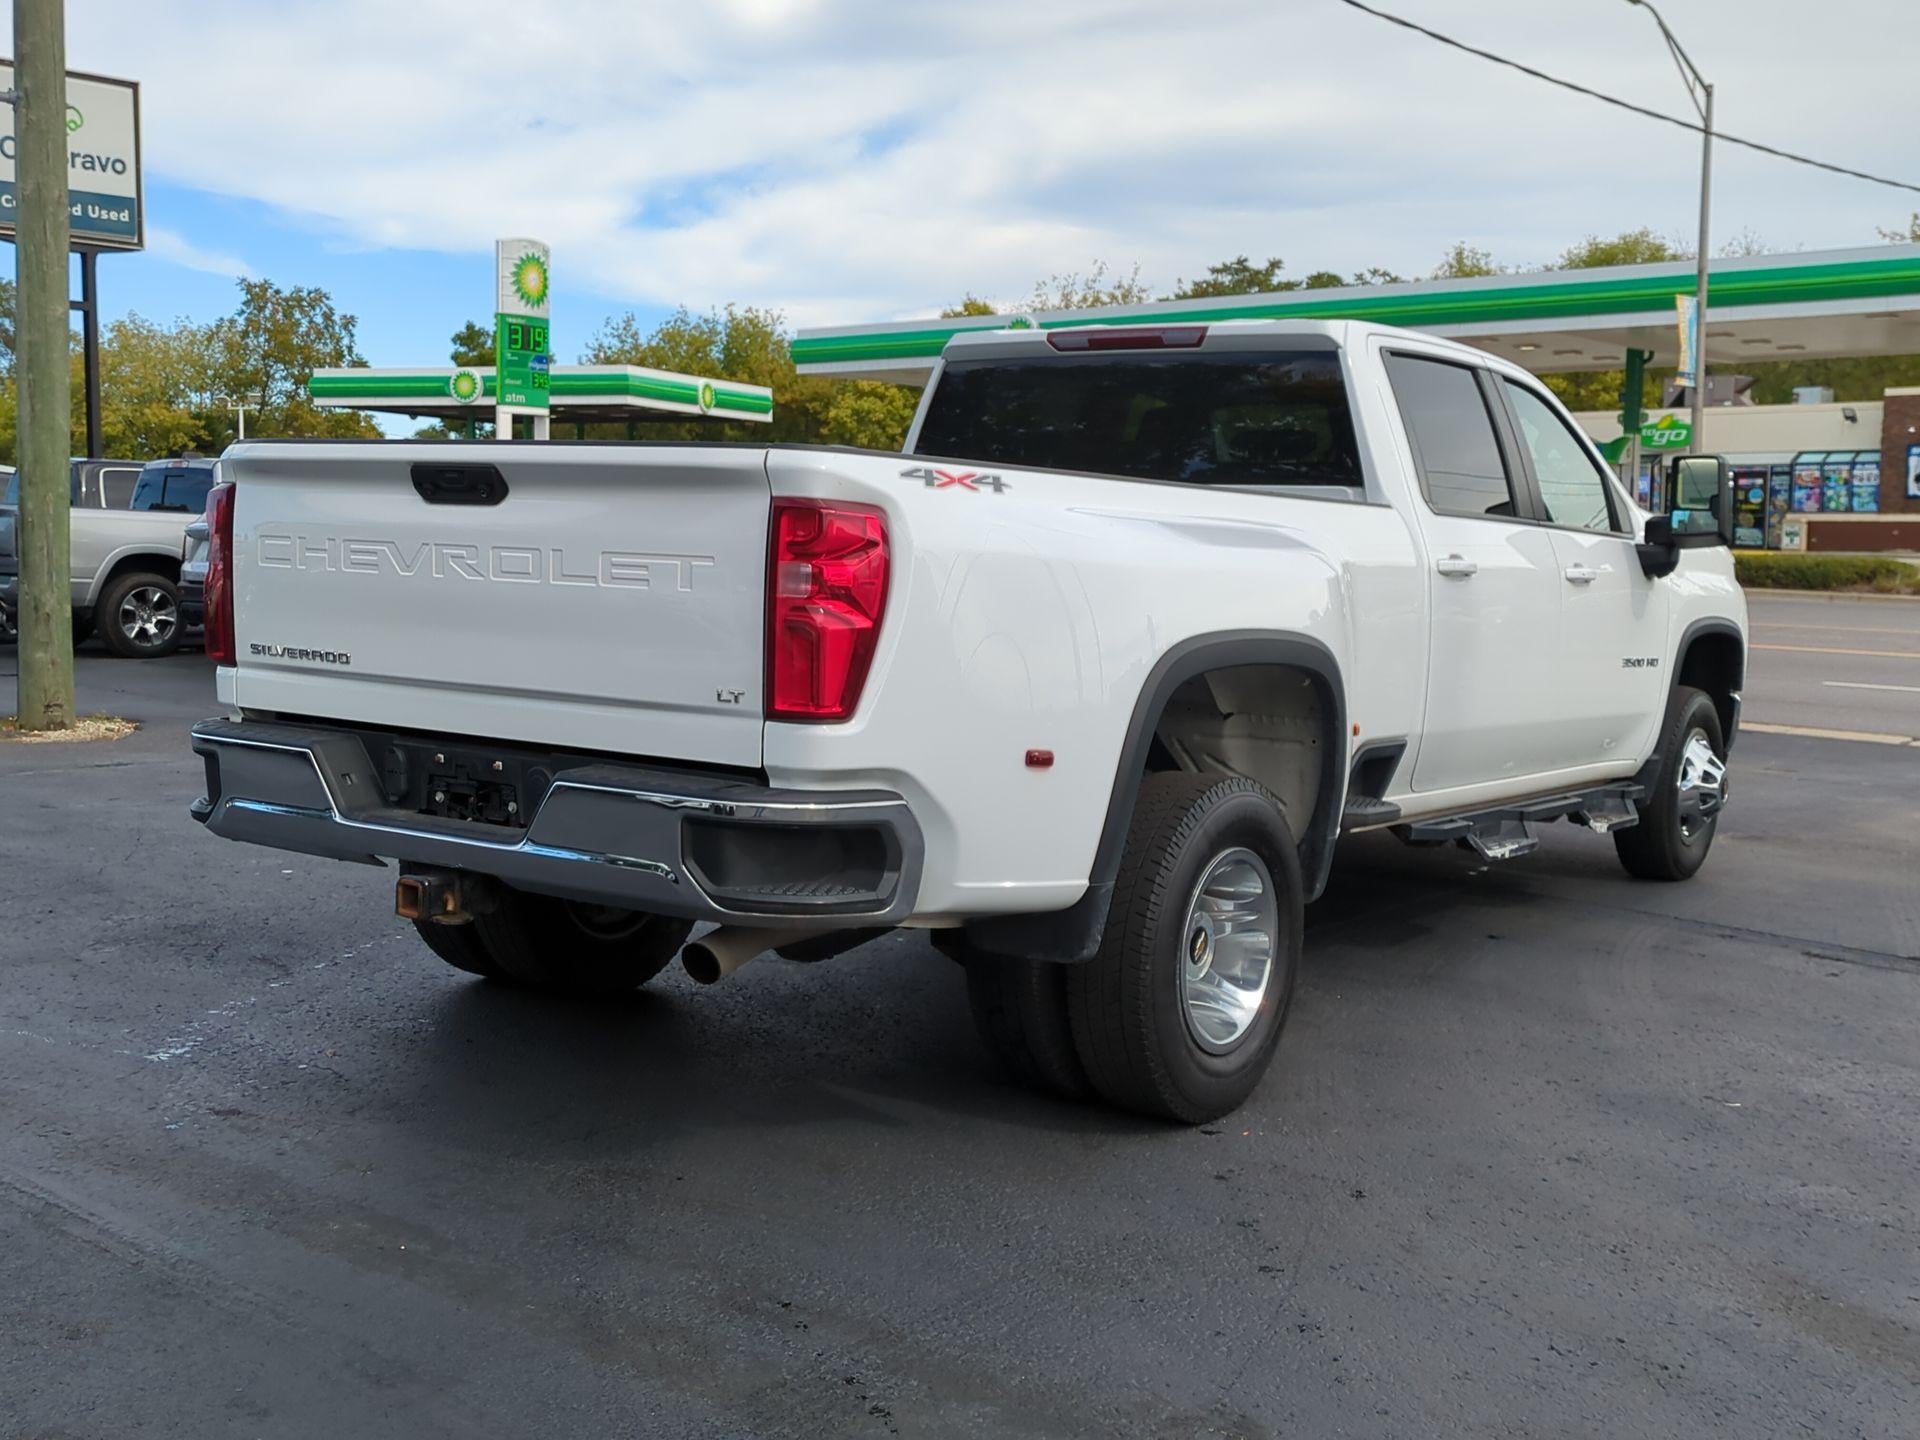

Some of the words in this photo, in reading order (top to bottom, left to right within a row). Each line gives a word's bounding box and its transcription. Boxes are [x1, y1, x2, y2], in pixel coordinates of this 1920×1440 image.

[87, 204, 130, 222] Used
[505, 392, 526, 403] atm
[1651, 428, 1689, 446] go
[257, 533, 716, 593] CHEVROLET
[250, 642, 351, 665] SILVERADO
[716, 689, 745, 704] LT
